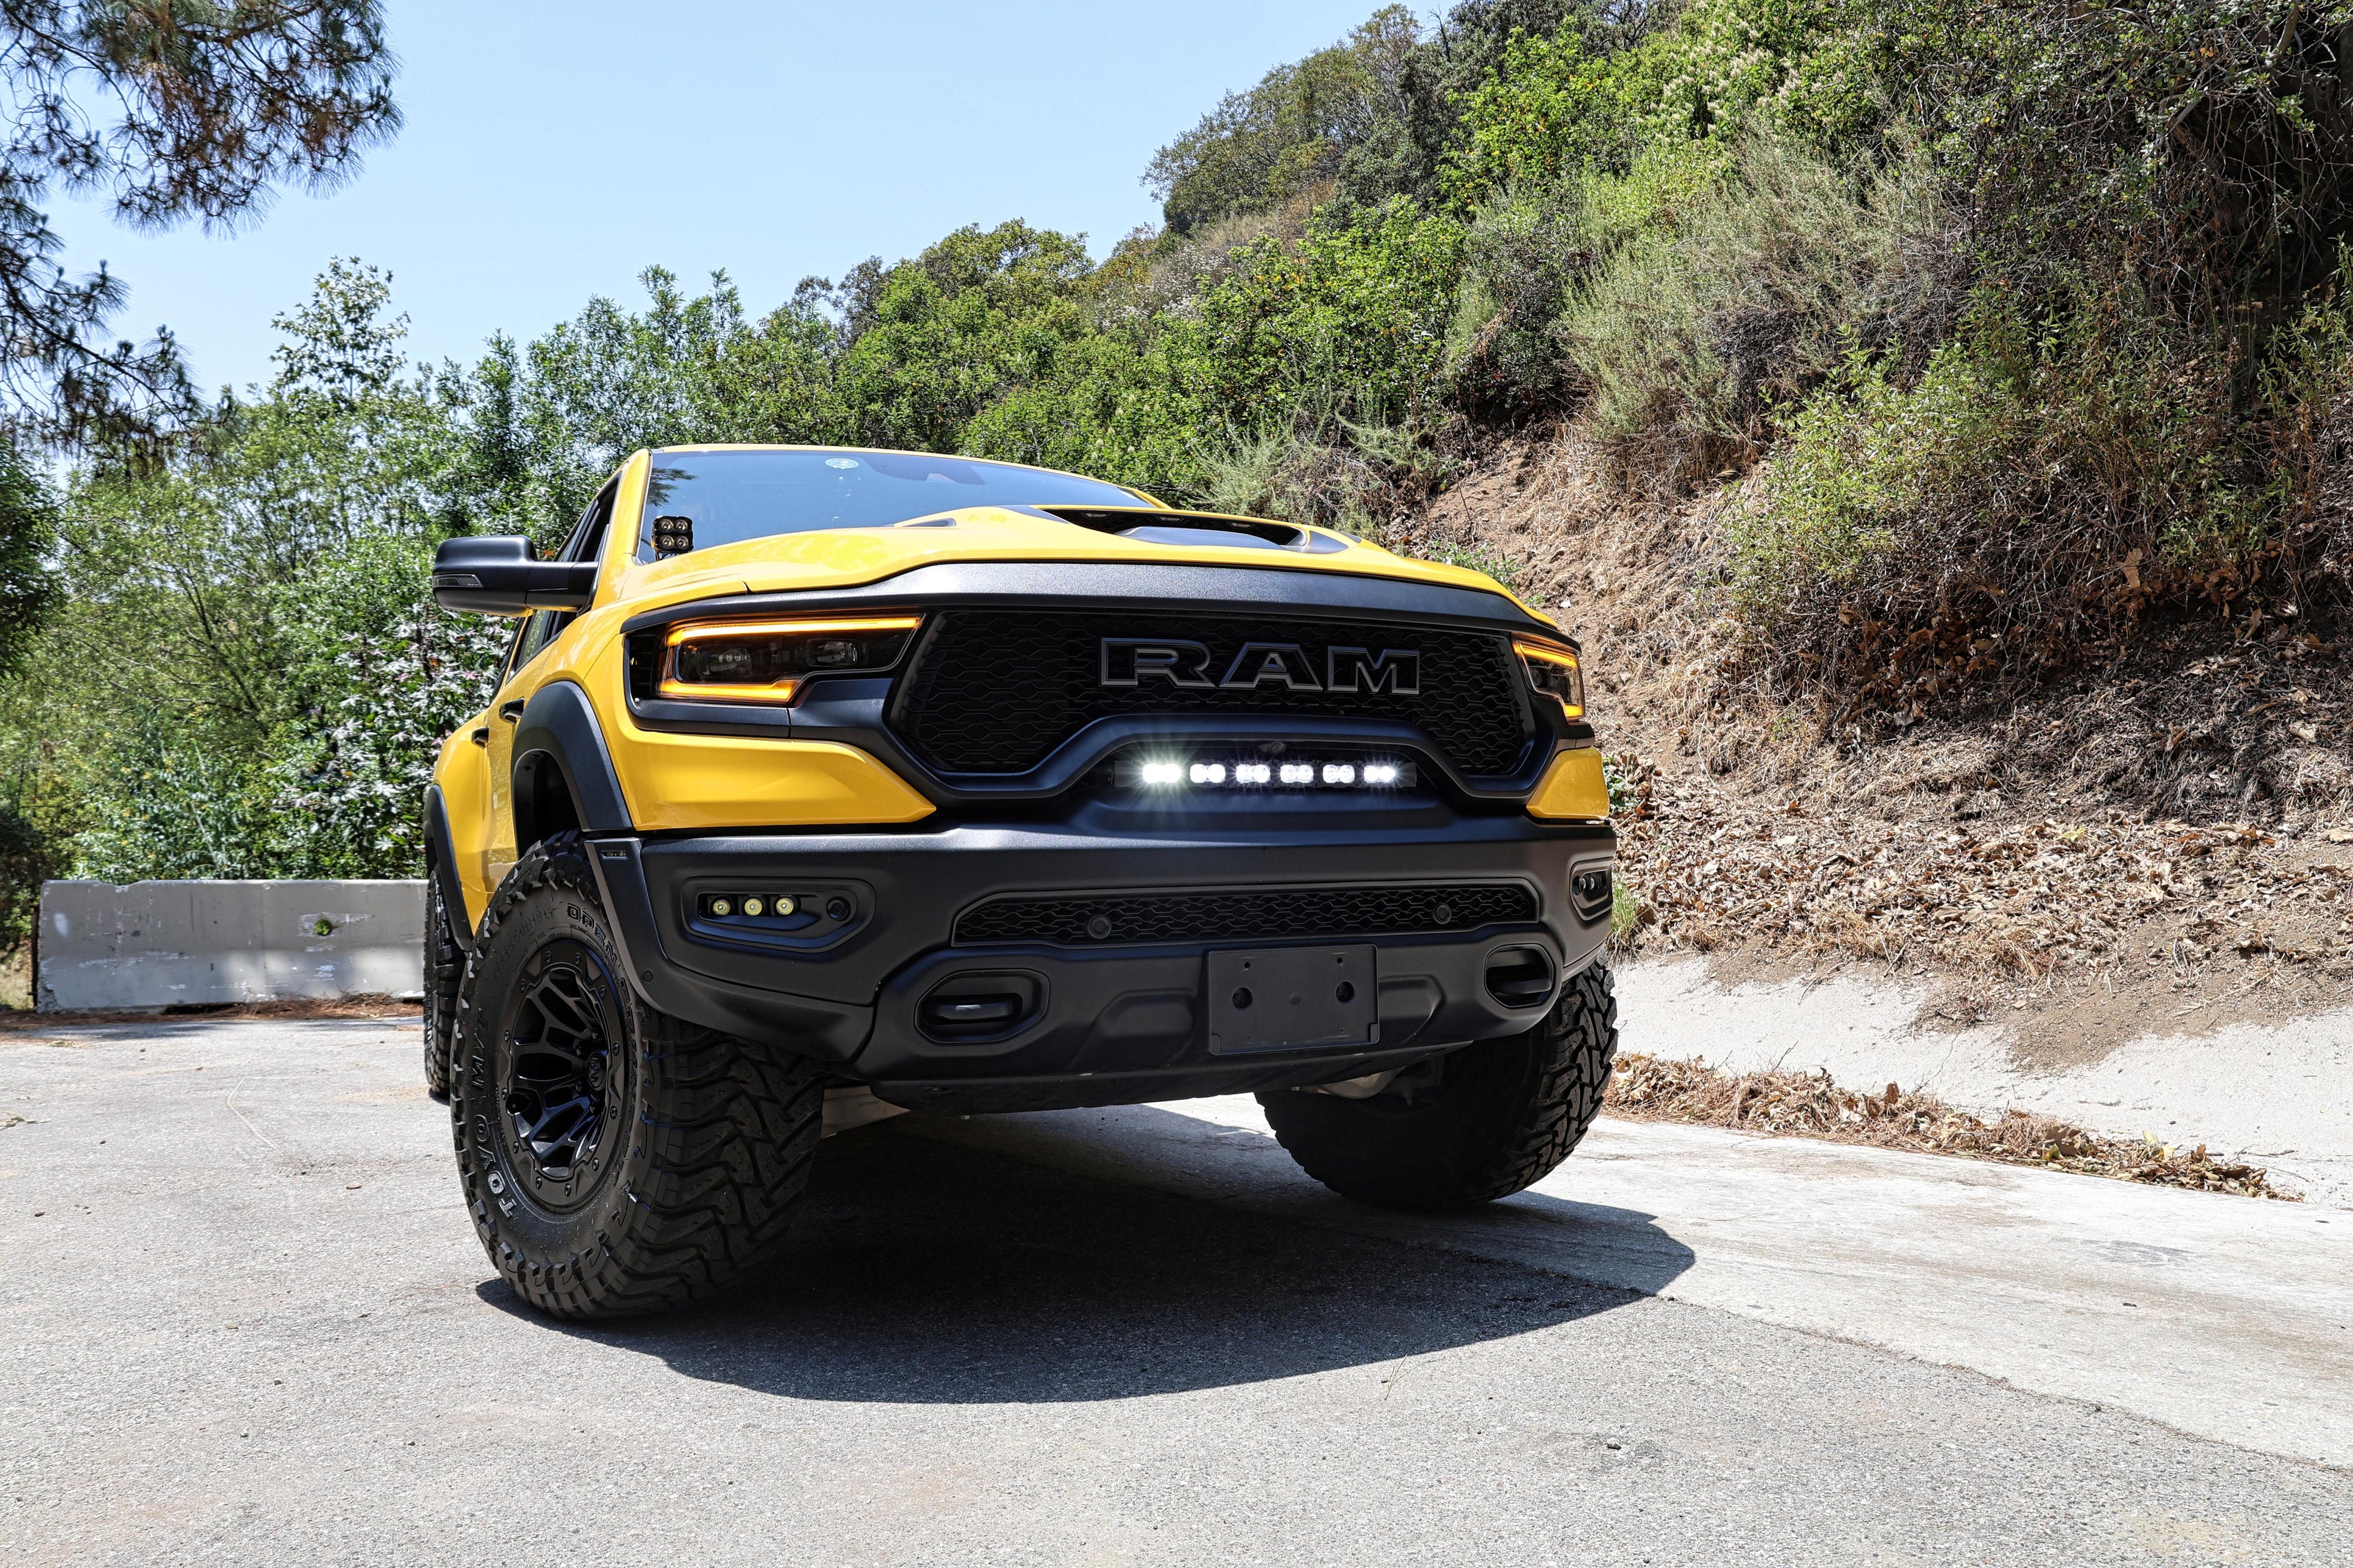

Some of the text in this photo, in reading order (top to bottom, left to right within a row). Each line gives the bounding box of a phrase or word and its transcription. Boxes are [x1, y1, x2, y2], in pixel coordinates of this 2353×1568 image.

[1100, 637, 1421, 695] RAM
[567, 902, 618, 967] OPEN
[471, 1007, 517, 1219] TOYO M/T
